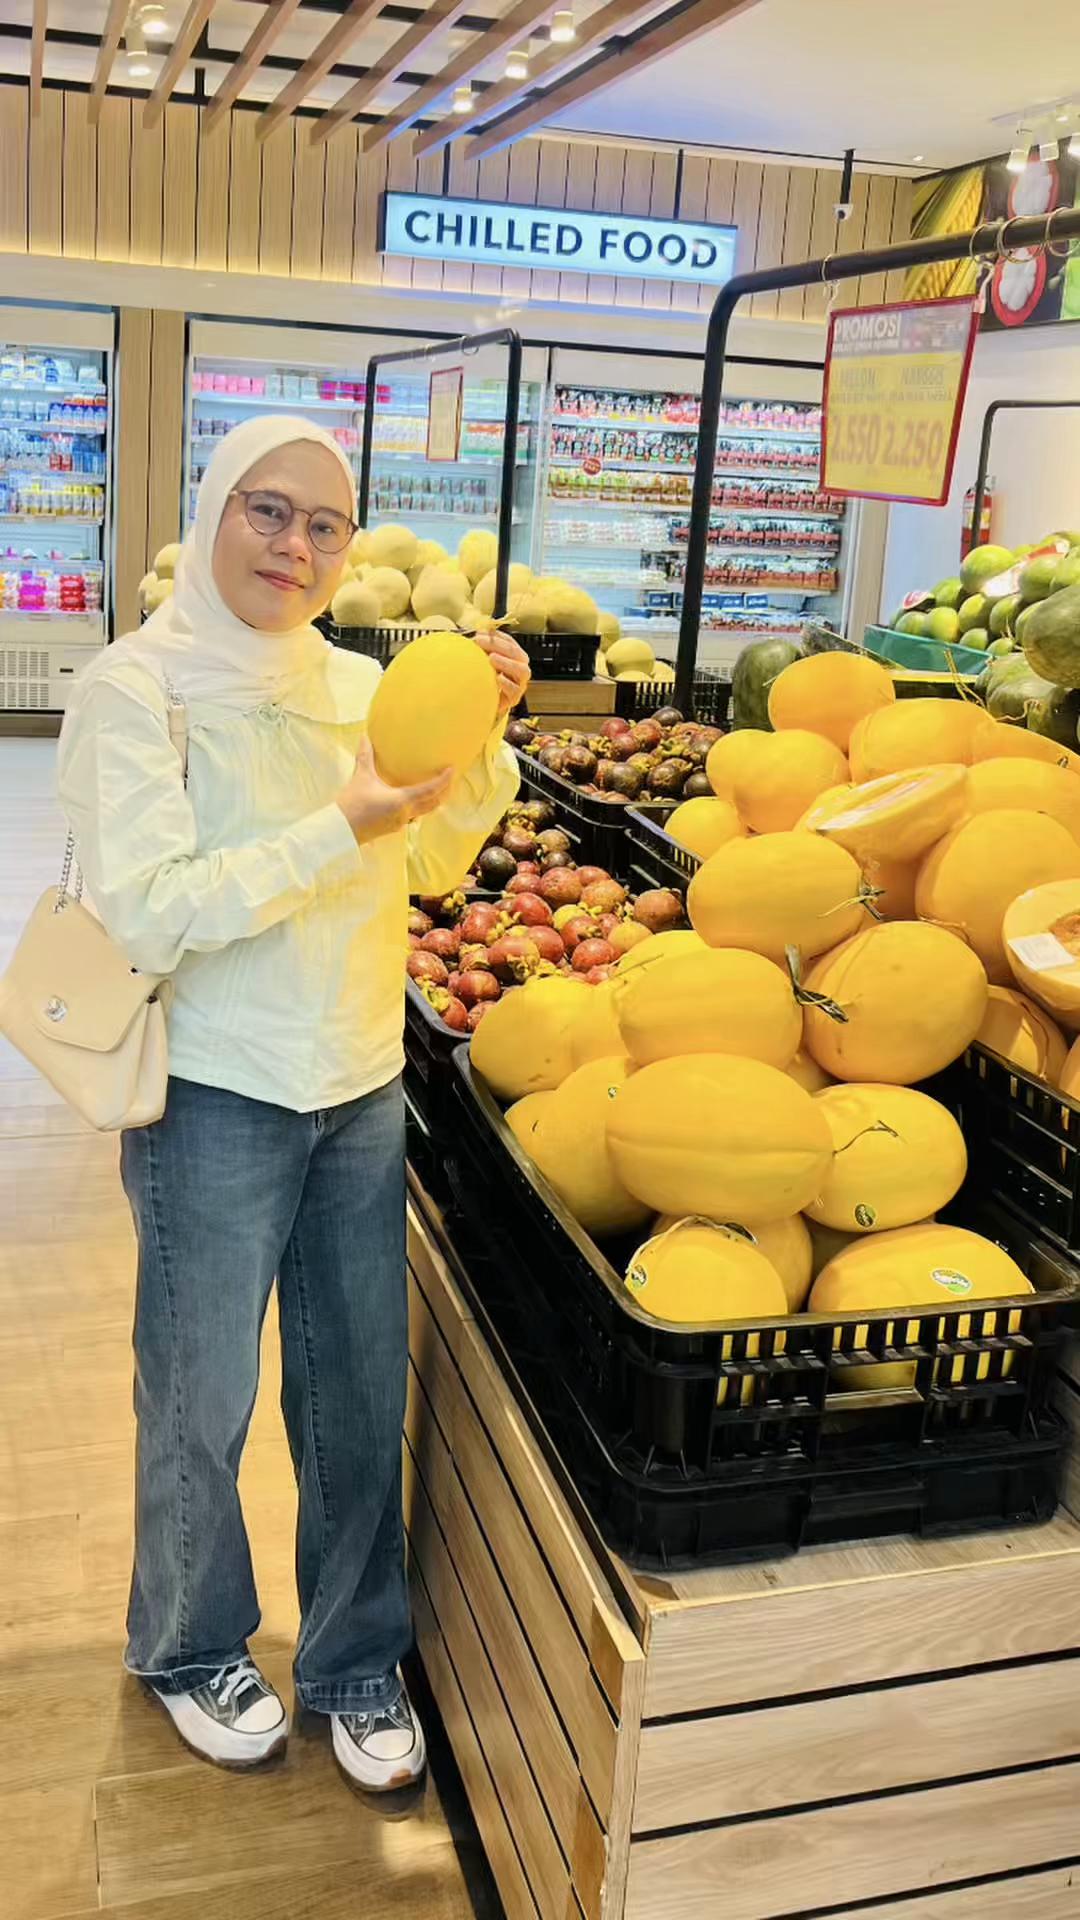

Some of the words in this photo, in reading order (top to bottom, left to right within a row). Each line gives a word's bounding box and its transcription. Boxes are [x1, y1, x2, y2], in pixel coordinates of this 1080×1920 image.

[405, 210, 583, 257] CHILLED
[600, 228, 718, 269] FOOD
[834, 312, 902, 341] PROMOSI
